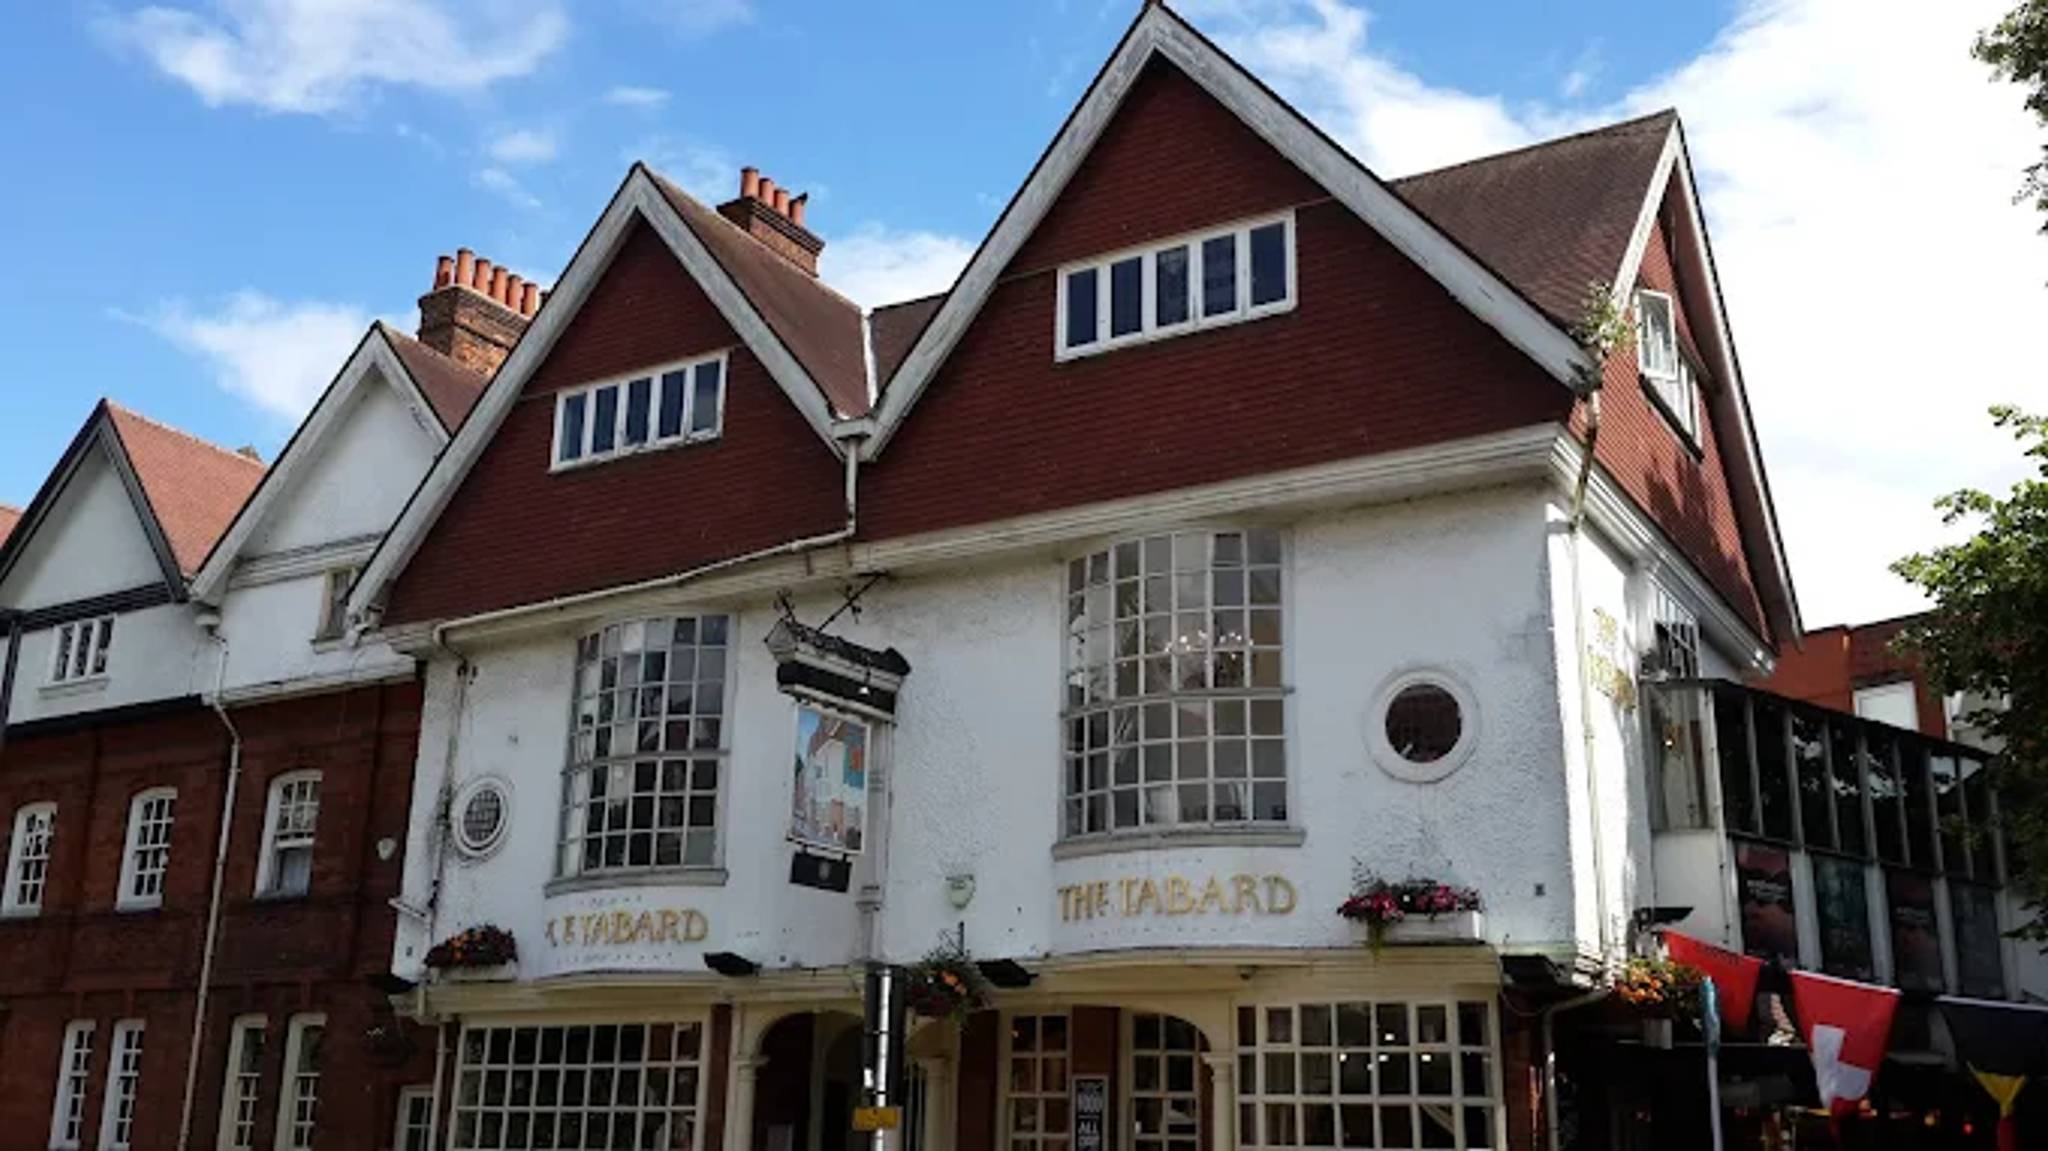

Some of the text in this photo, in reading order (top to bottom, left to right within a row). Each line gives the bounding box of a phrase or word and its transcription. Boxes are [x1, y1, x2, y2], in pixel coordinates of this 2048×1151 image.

[1057, 873, 1297, 923] THE TABARD
[579, 906, 709, 946] TABARD
